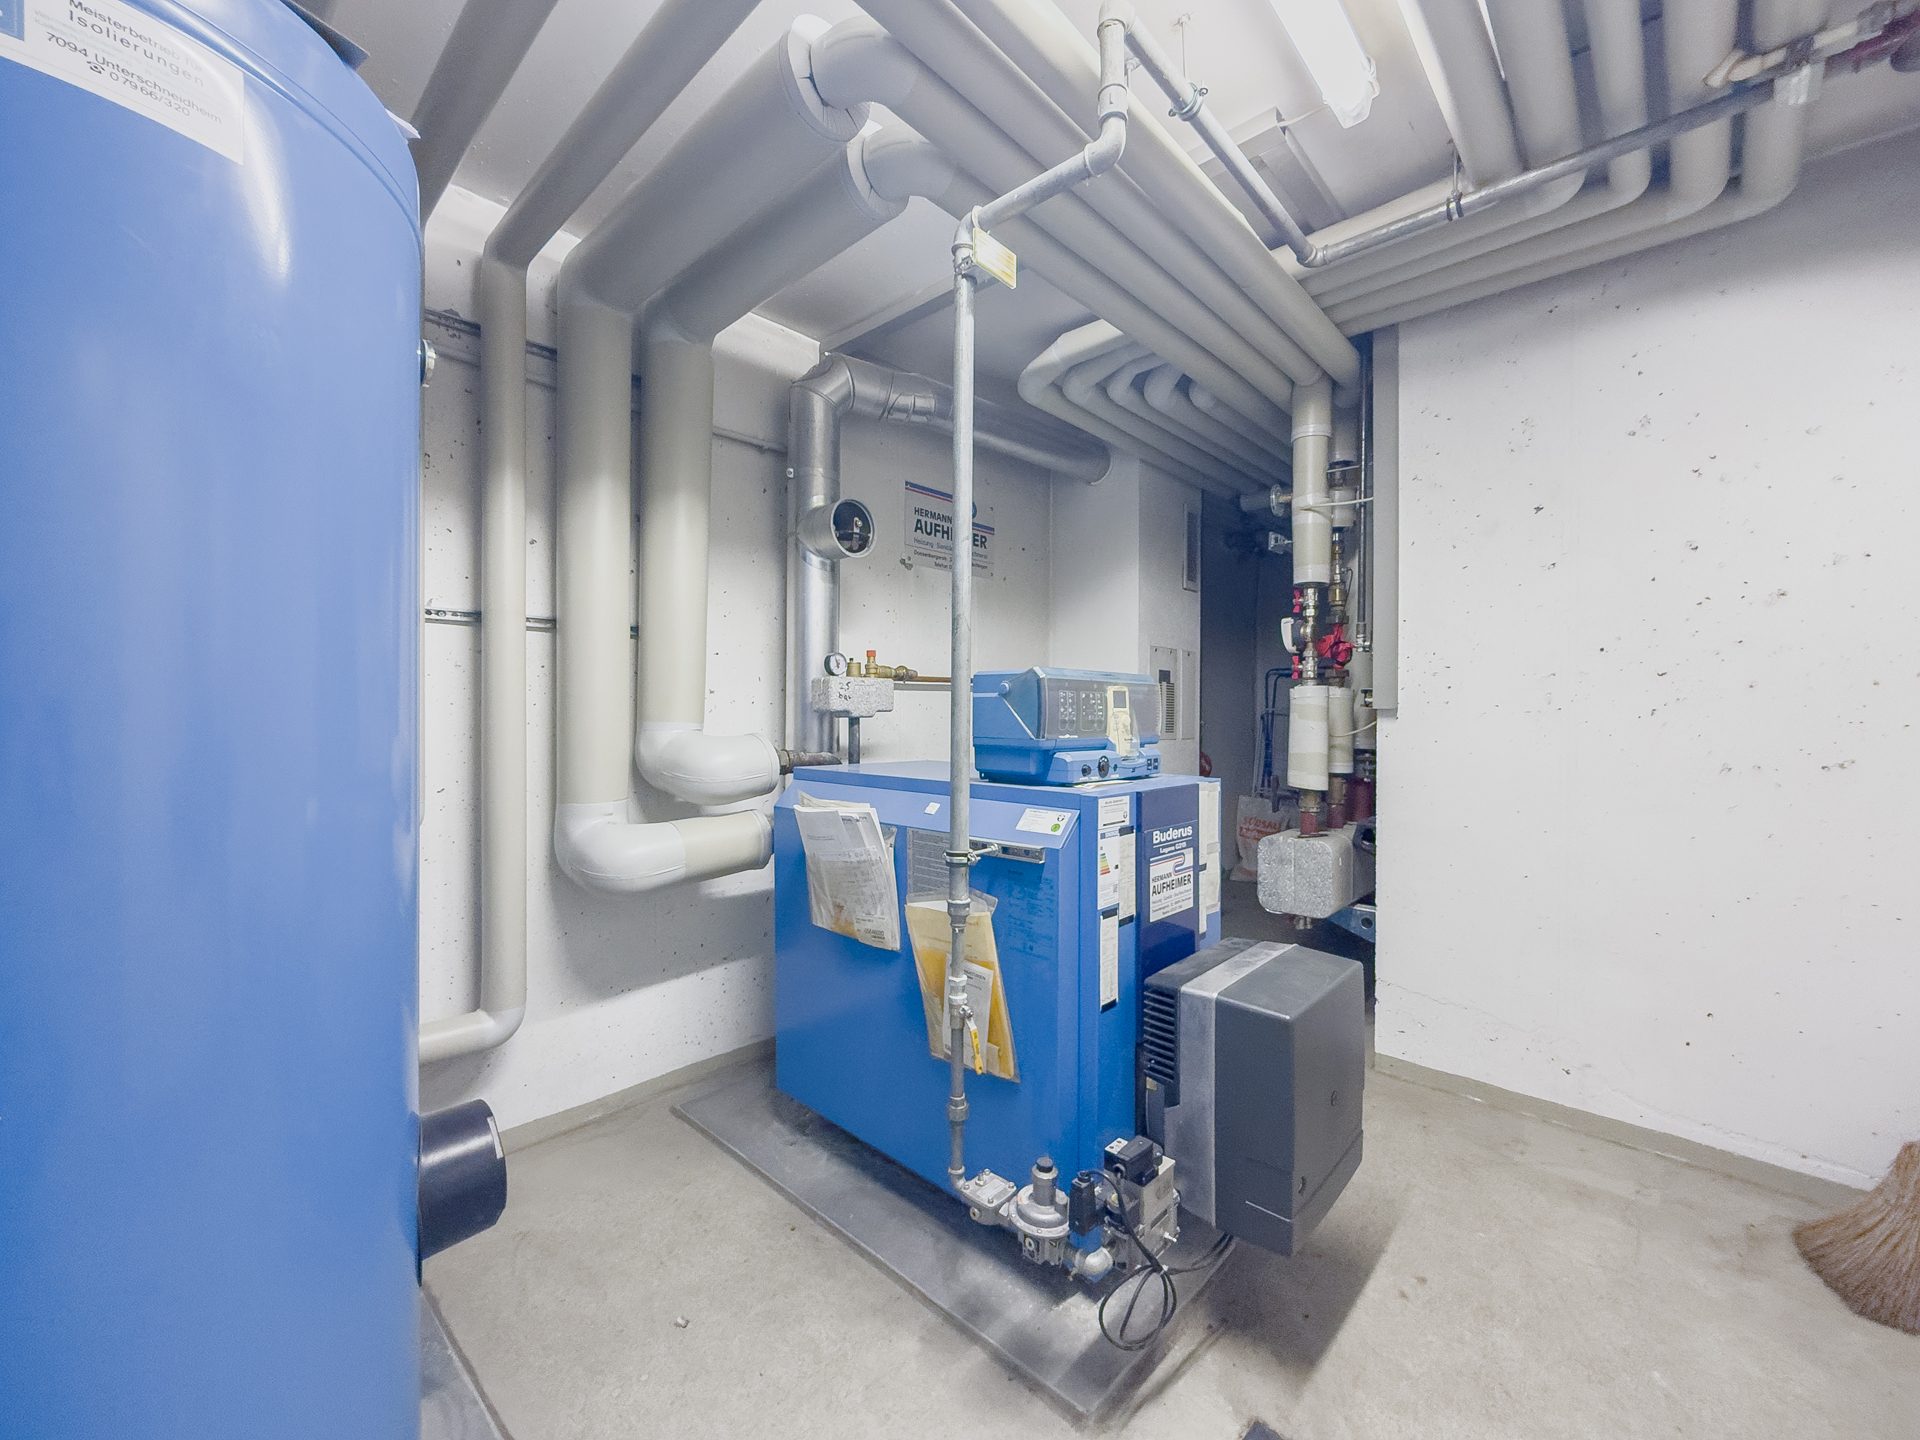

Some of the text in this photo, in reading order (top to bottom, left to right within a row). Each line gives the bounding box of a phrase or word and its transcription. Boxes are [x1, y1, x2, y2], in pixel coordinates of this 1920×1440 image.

[69, 10, 204, 87] Isolierungen
[47, 32, 89, 57] 7094
[94, 53, 222, 125] Unterschneidheim
[914, 506, 952, 524] HERMANN
[1152, 825, 1192, 844] Buderus
[1152, 872, 1173, 883] HERMANN
[1152, 873, 1192, 896] AUFHEIMER
